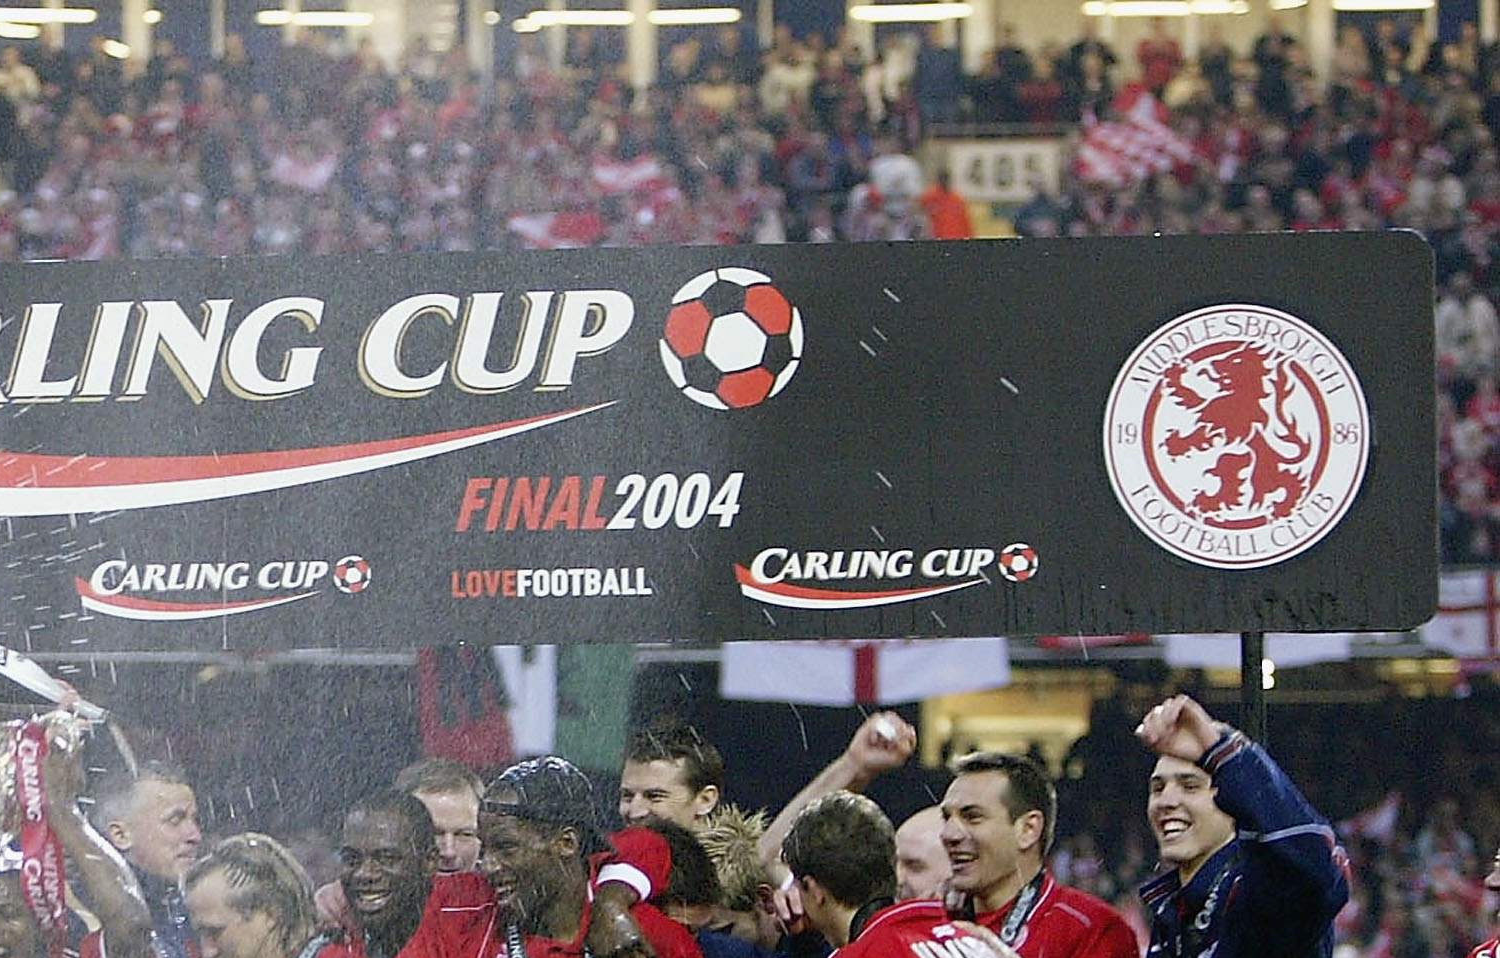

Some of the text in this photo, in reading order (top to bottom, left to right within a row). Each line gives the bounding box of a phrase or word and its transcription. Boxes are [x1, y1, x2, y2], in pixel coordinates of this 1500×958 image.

[357, 289, 635, 399] CUP
[1131, 314, 1346, 395] MIDDLESBROUGH
[1116, 421, 1359, 445] 19 86
[1131, 484, 1335, 557] FOOTBALL CLUB
[90, 560, 329, 596] CARLING CUP
[750, 547, 995, 585] CARLING CUP
